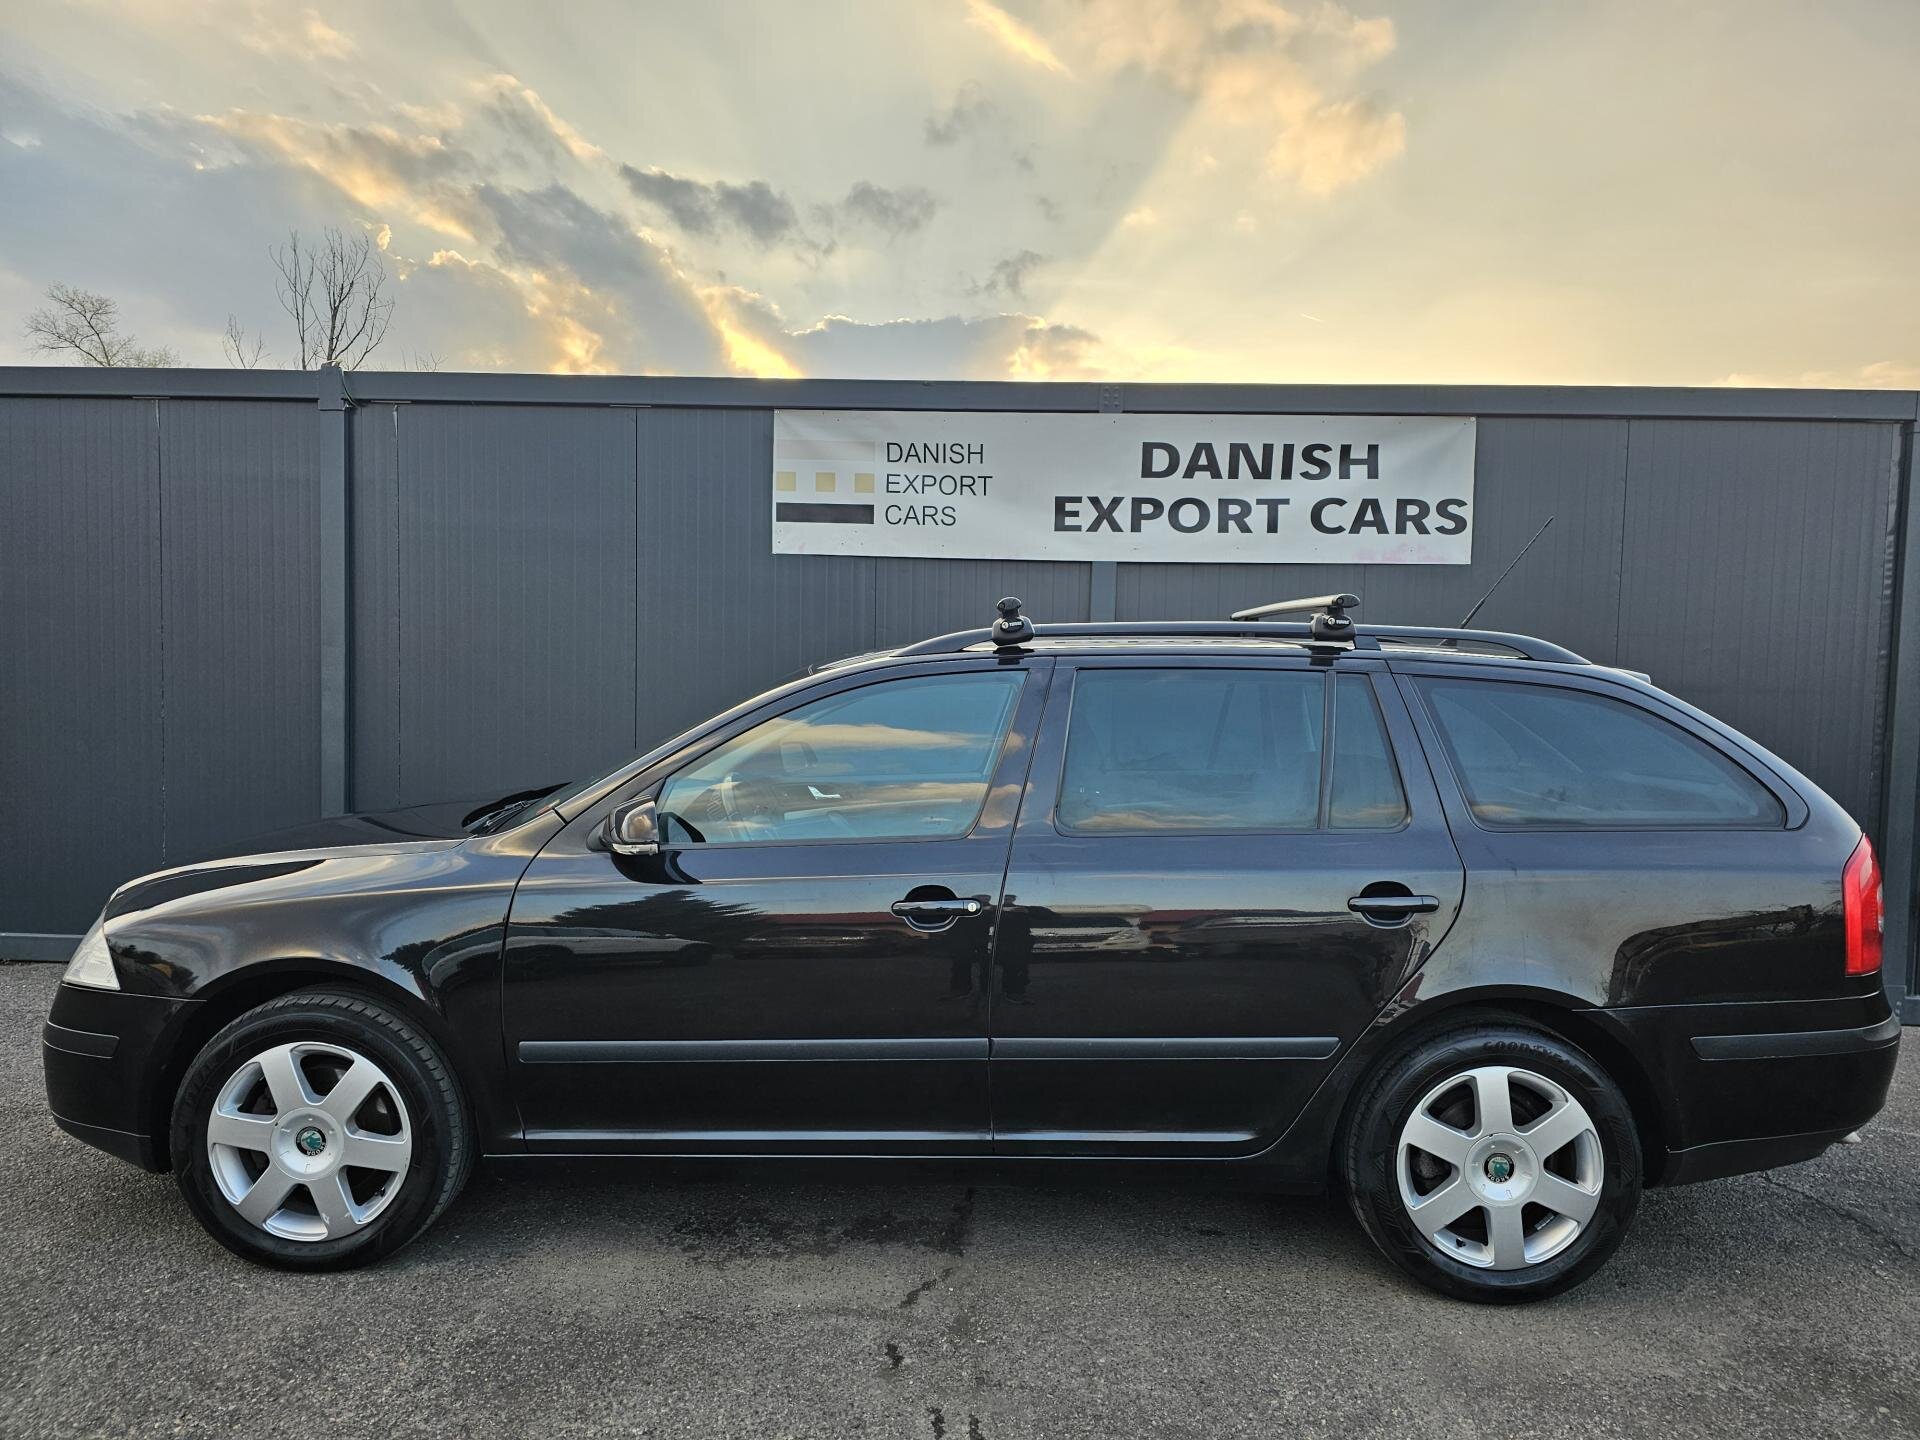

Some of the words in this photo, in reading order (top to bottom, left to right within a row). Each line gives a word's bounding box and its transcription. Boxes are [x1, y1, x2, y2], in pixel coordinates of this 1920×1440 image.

[885, 442, 984, 465] DANISH
[1141, 441, 1380, 480] DANISH
[885, 473, 993, 497] EXPORT
[885, 504, 957, 527] CARS
[1053, 496, 1291, 534] EXPORT
[1310, 498, 1468, 536] CARS
